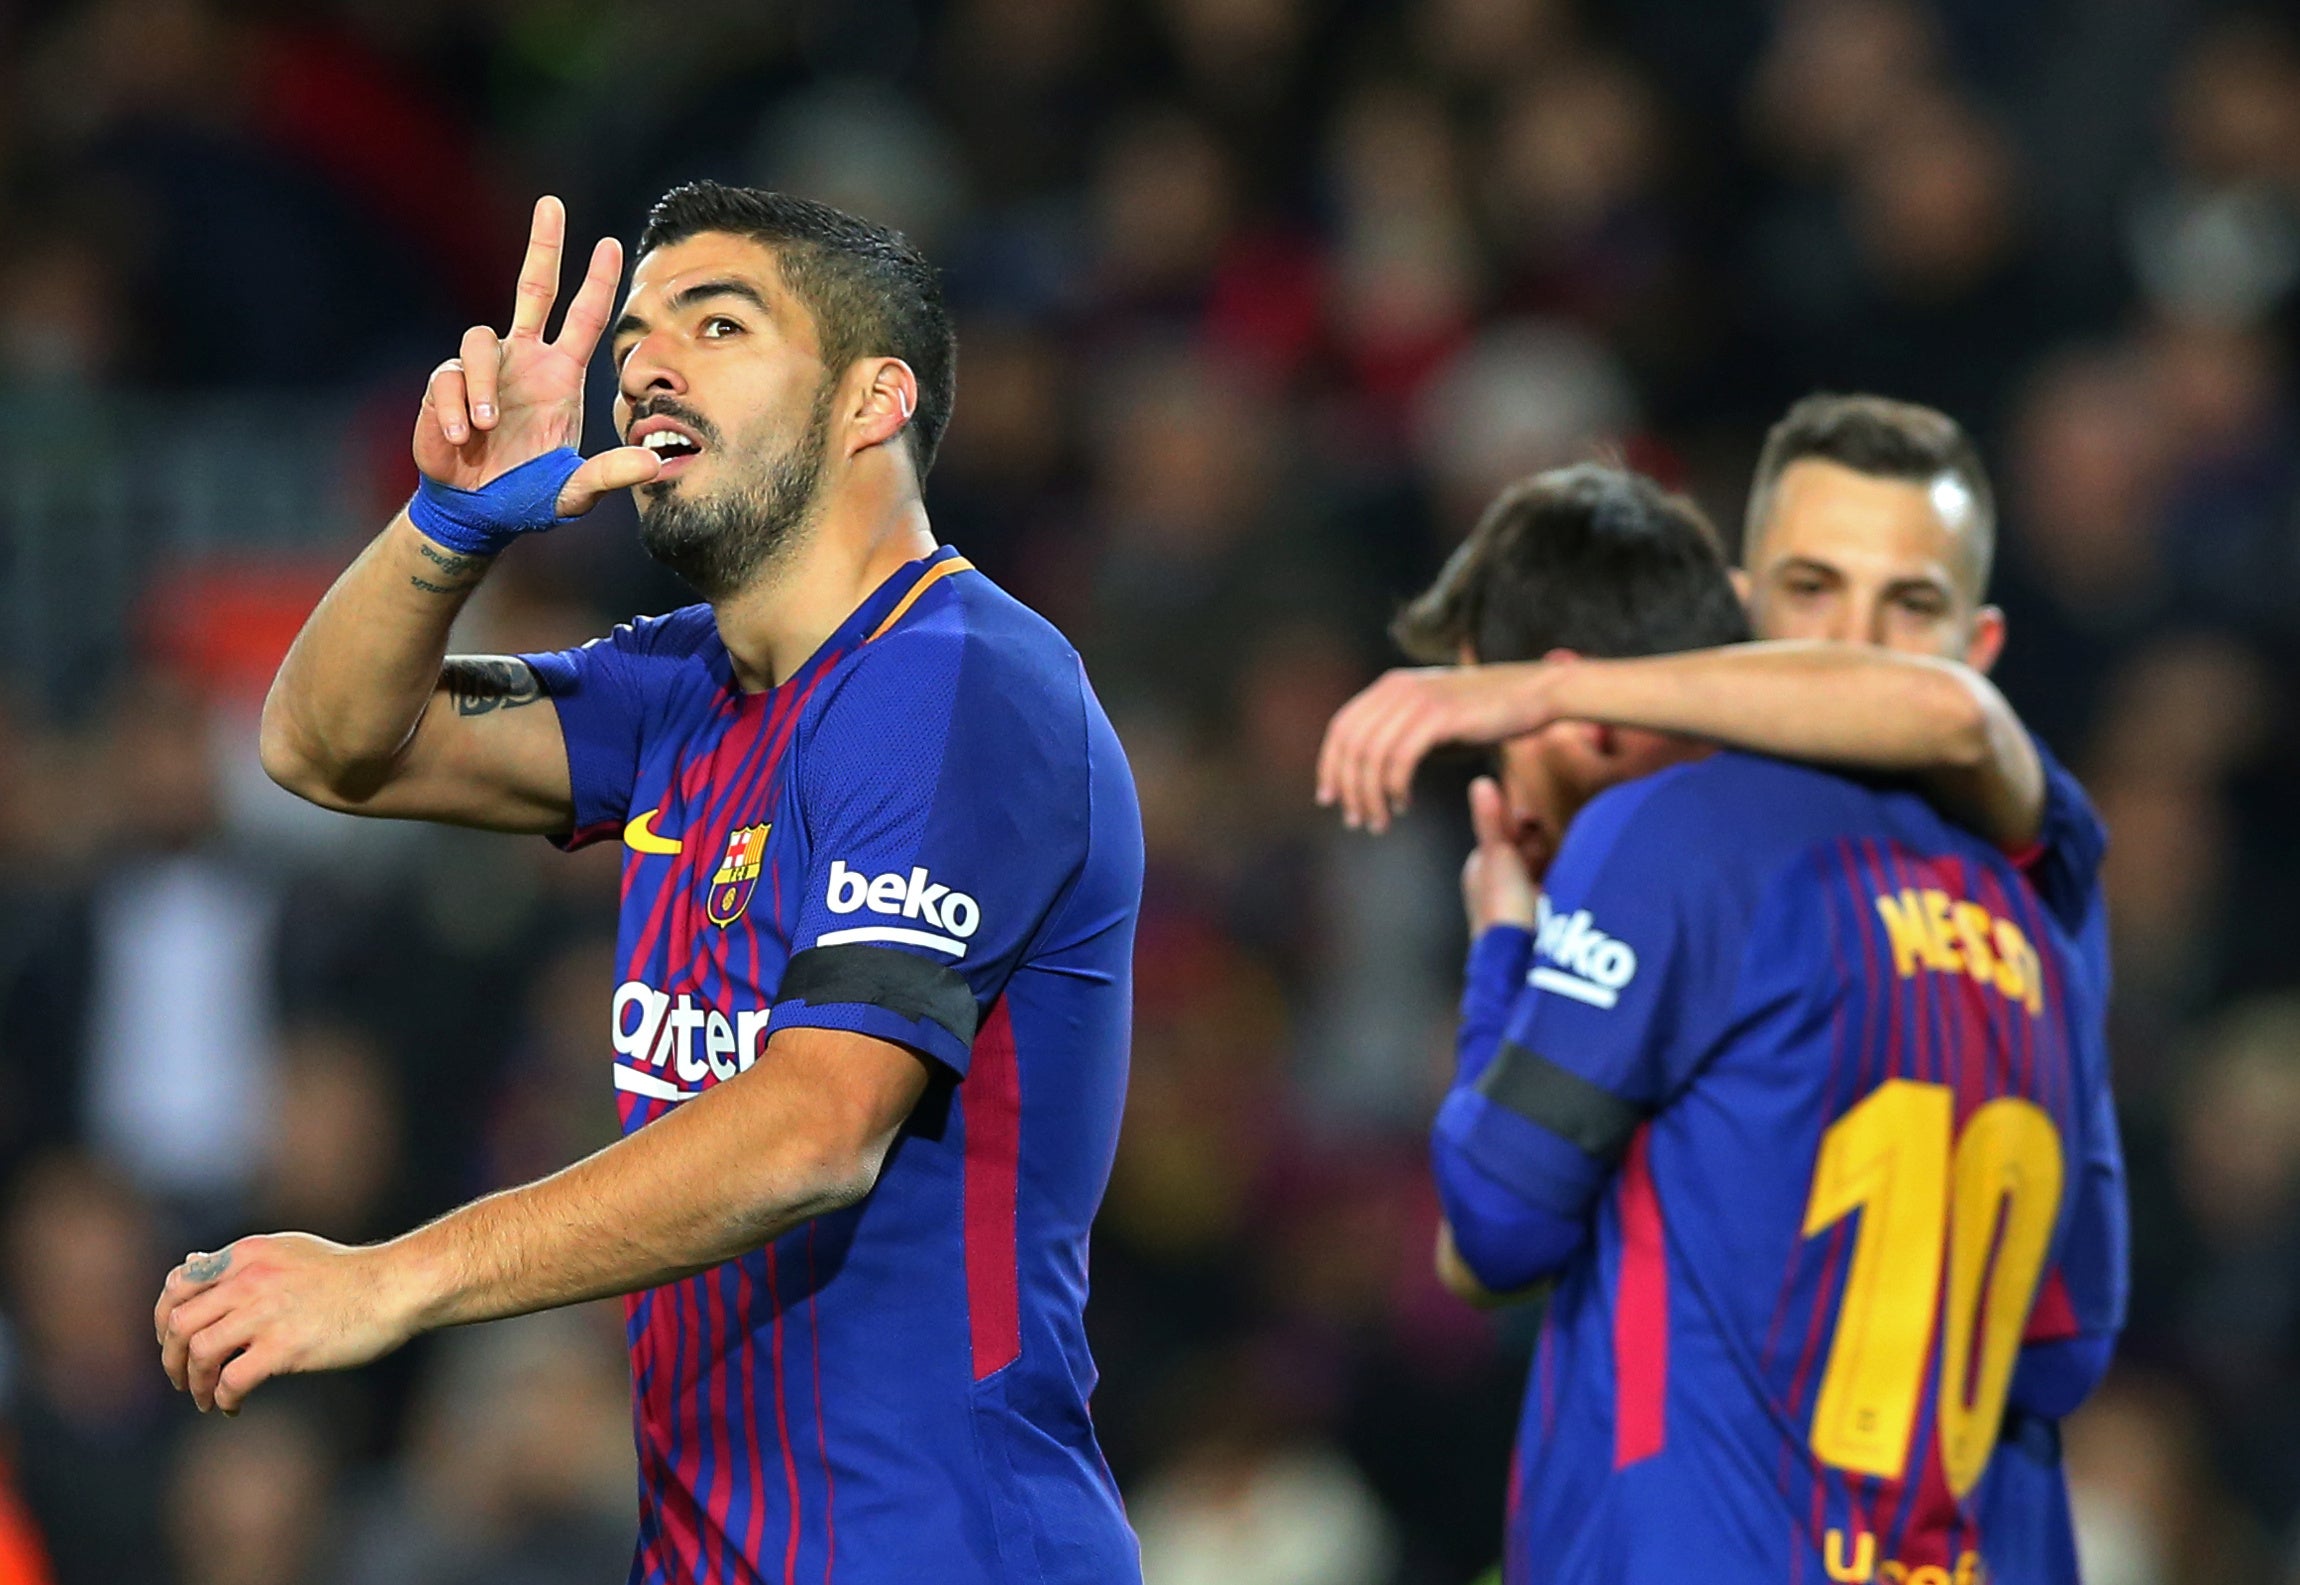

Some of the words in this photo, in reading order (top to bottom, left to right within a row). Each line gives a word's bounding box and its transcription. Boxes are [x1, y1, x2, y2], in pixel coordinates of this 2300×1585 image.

[826, 860, 981, 938] beko
[1876, 887, 2044, 1018] MESSI
[1802, 1077, 2064, 1499] 10
